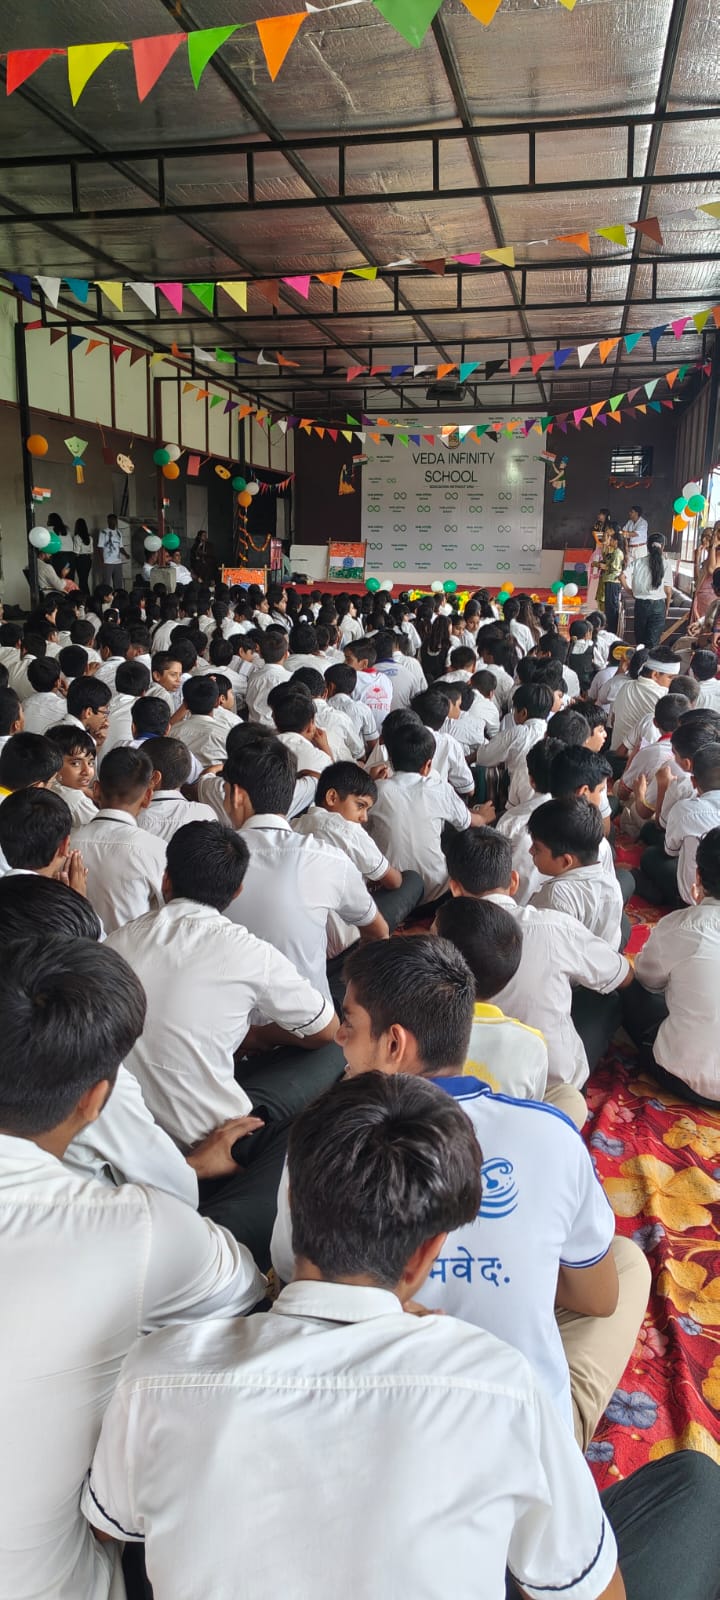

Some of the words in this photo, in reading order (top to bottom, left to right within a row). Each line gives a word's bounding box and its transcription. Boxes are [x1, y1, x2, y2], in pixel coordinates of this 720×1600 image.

[412, 452, 445, 465] VEDA
[448, 452, 496, 465] INFINITY
[424, 470, 478, 483] SCHOOL
